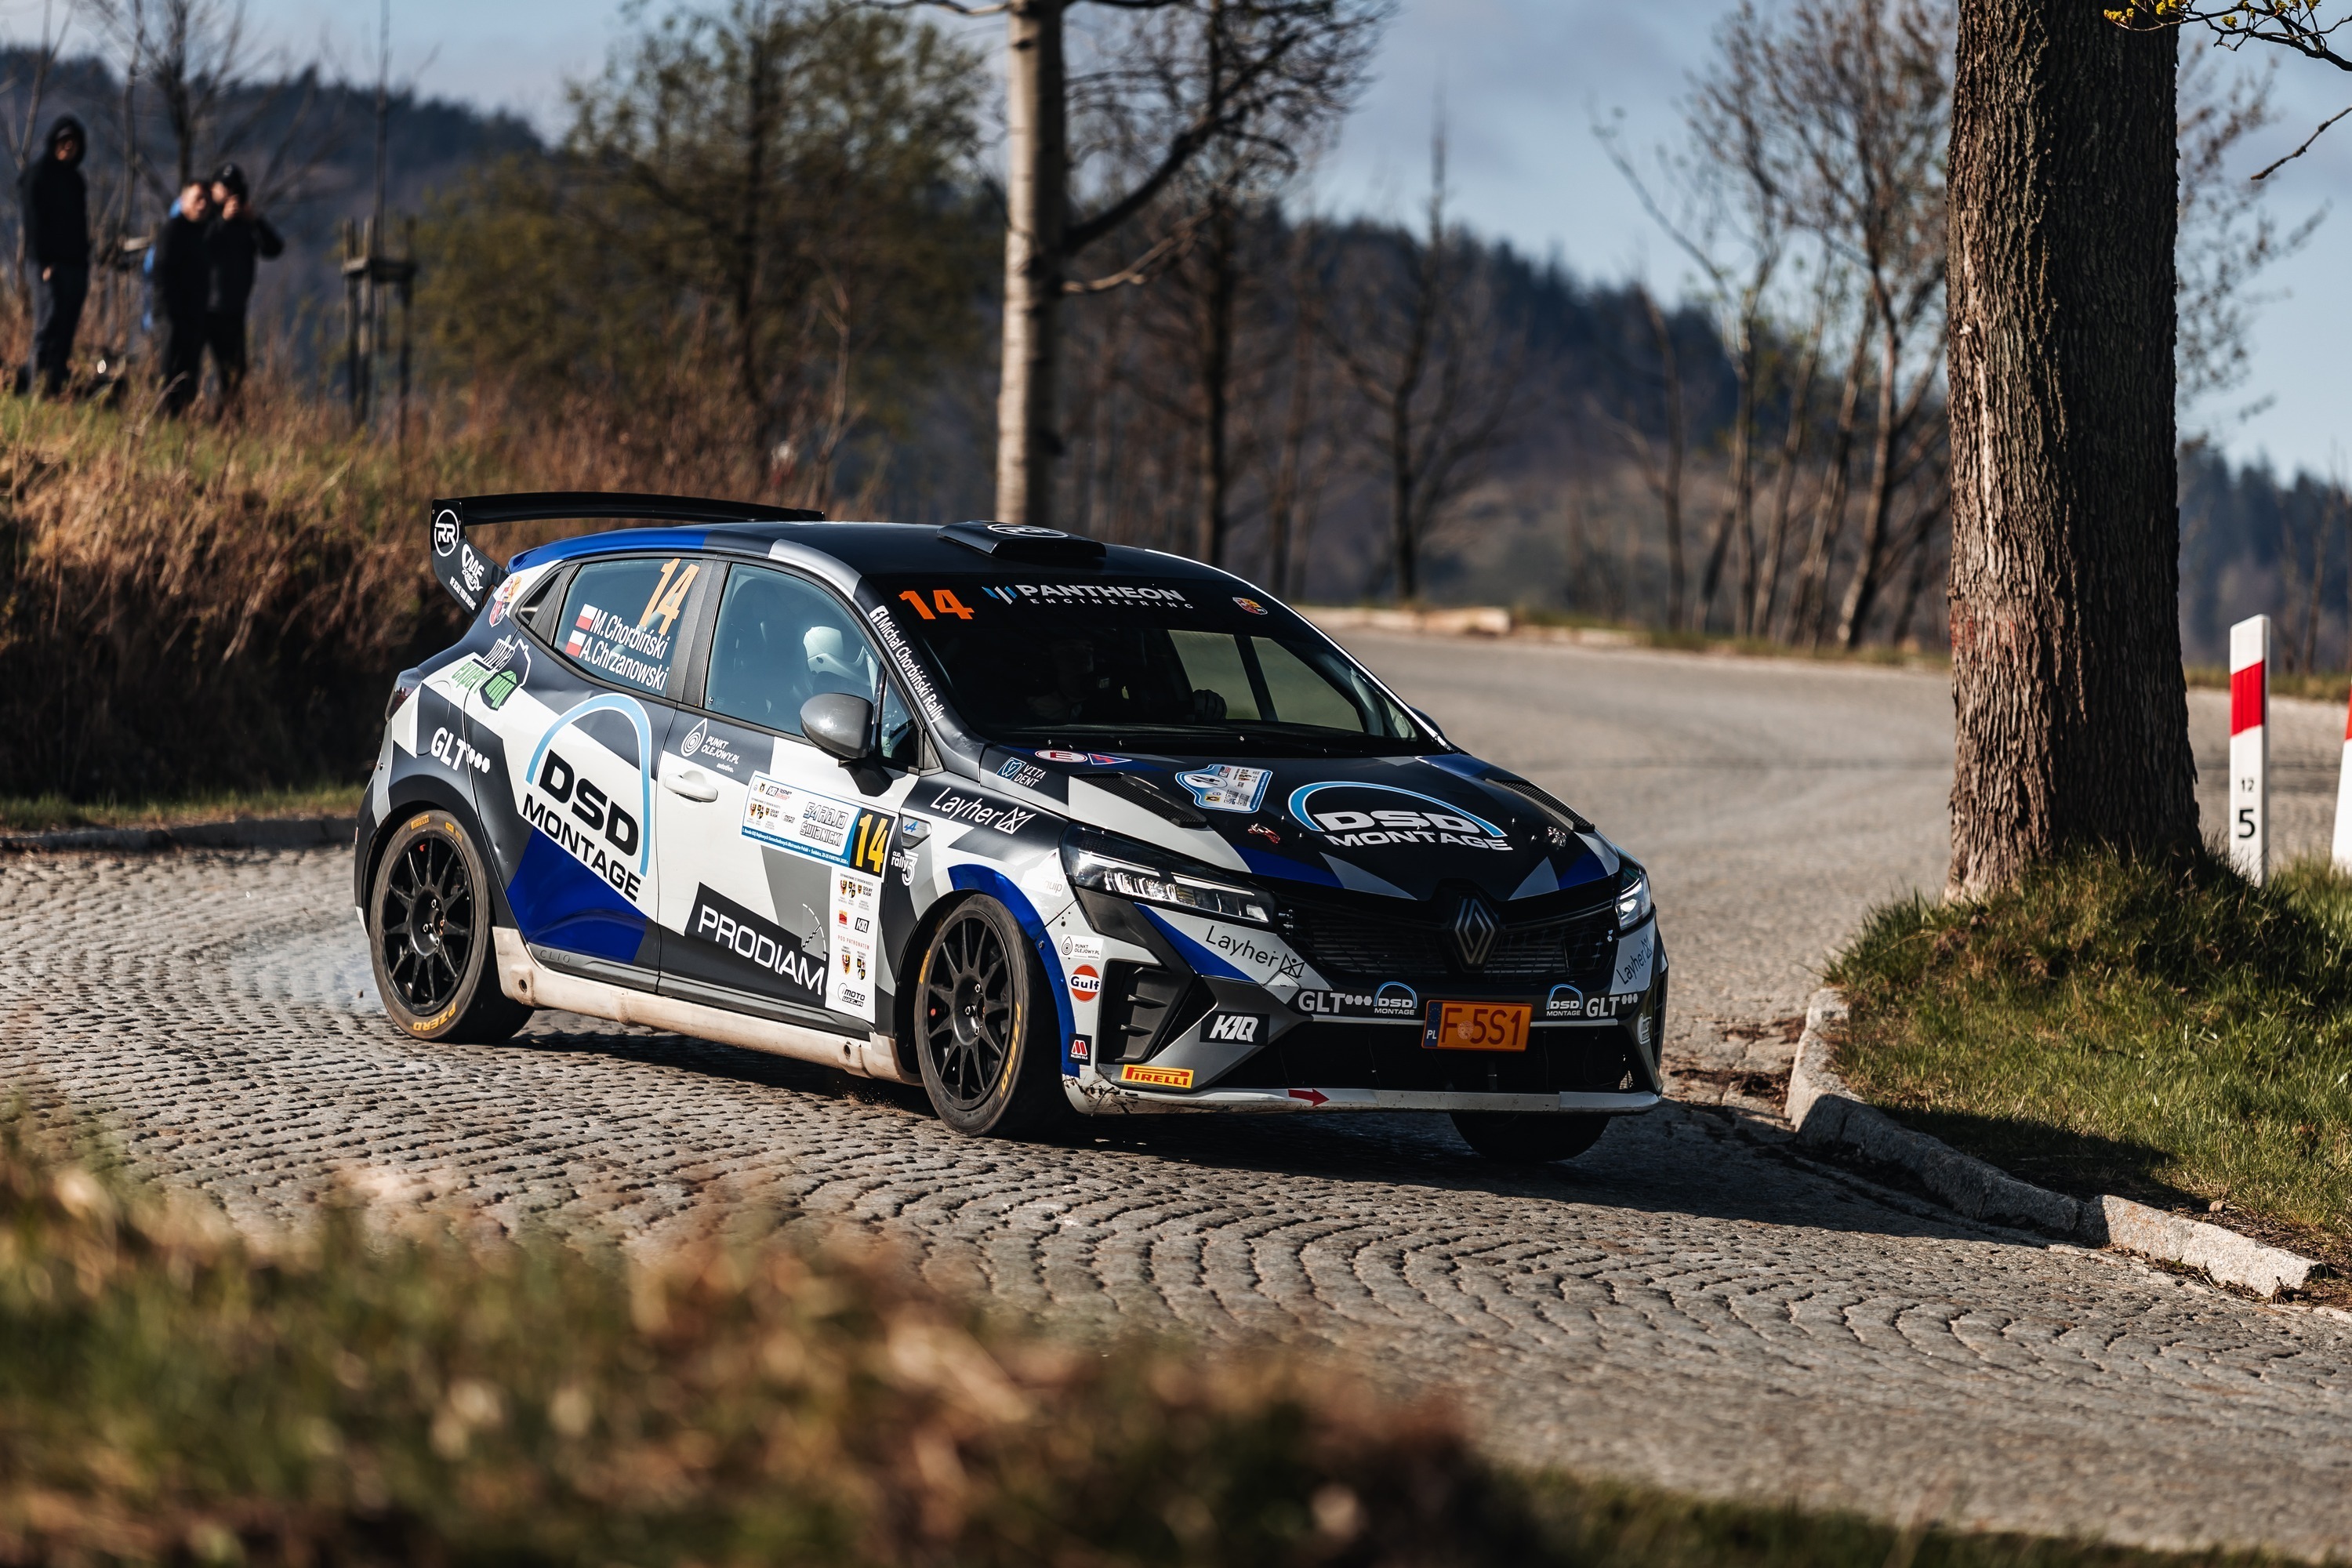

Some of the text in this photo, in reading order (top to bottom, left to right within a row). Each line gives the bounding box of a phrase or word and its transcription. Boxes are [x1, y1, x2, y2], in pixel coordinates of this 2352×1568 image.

[639, 558, 699, 636] 14
[1014, 585, 1186, 601] PANTHEON
[1029, 598, 1193, 610] ENGINEERING
[898, 590, 975, 619] 14
[590, 609, 670, 660] M.Chorbiński
[579, 637, 670, 691] A.Chrzanowski
[877, 616, 906, 651] Michał
[895, 647, 935, 699] Chorbiński
[923, 693, 945, 724] Rally
[430, 727, 470, 771] GLT
[706, 735, 729, 750] PUNKT
[701, 745, 740, 764] OLEJOWY.PL
[1014, 775, 1039, 787] DENT
[1023, 764, 1046, 779] VITA
[2241, 778, 2255, 793] 12
[539, 749, 639, 856] DSD
[930, 788, 1004, 826] Layher
[1313, 811, 1483, 833] DSD
[2238, 809, 2256, 839] 5
[522, 793, 641, 902] MONTAGE
[856, 814, 888, 873] 14
[1323, 829, 1514, 851] MONTAGE
[891, 855, 909, 872] rally
[539, 949, 571, 964] CLIO
[698, 904, 826, 996] PRODIAM
[1206, 925, 1279, 968] Layher
[1616, 949, 1646, 985] Layher
[1070, 976, 1099, 990] Gulf
[844, 989, 866, 1000] MOTO
[1298, 990, 1346, 1014] GLT
[1378, 998, 1413, 1007] DSD
[1550, 1000, 1580, 1009] DSD
[1586, 996, 1620, 1018] GLT
[1426, 1029, 1437, 1040] PL
[1125, 1067, 1192, 1087] PIRELLI
